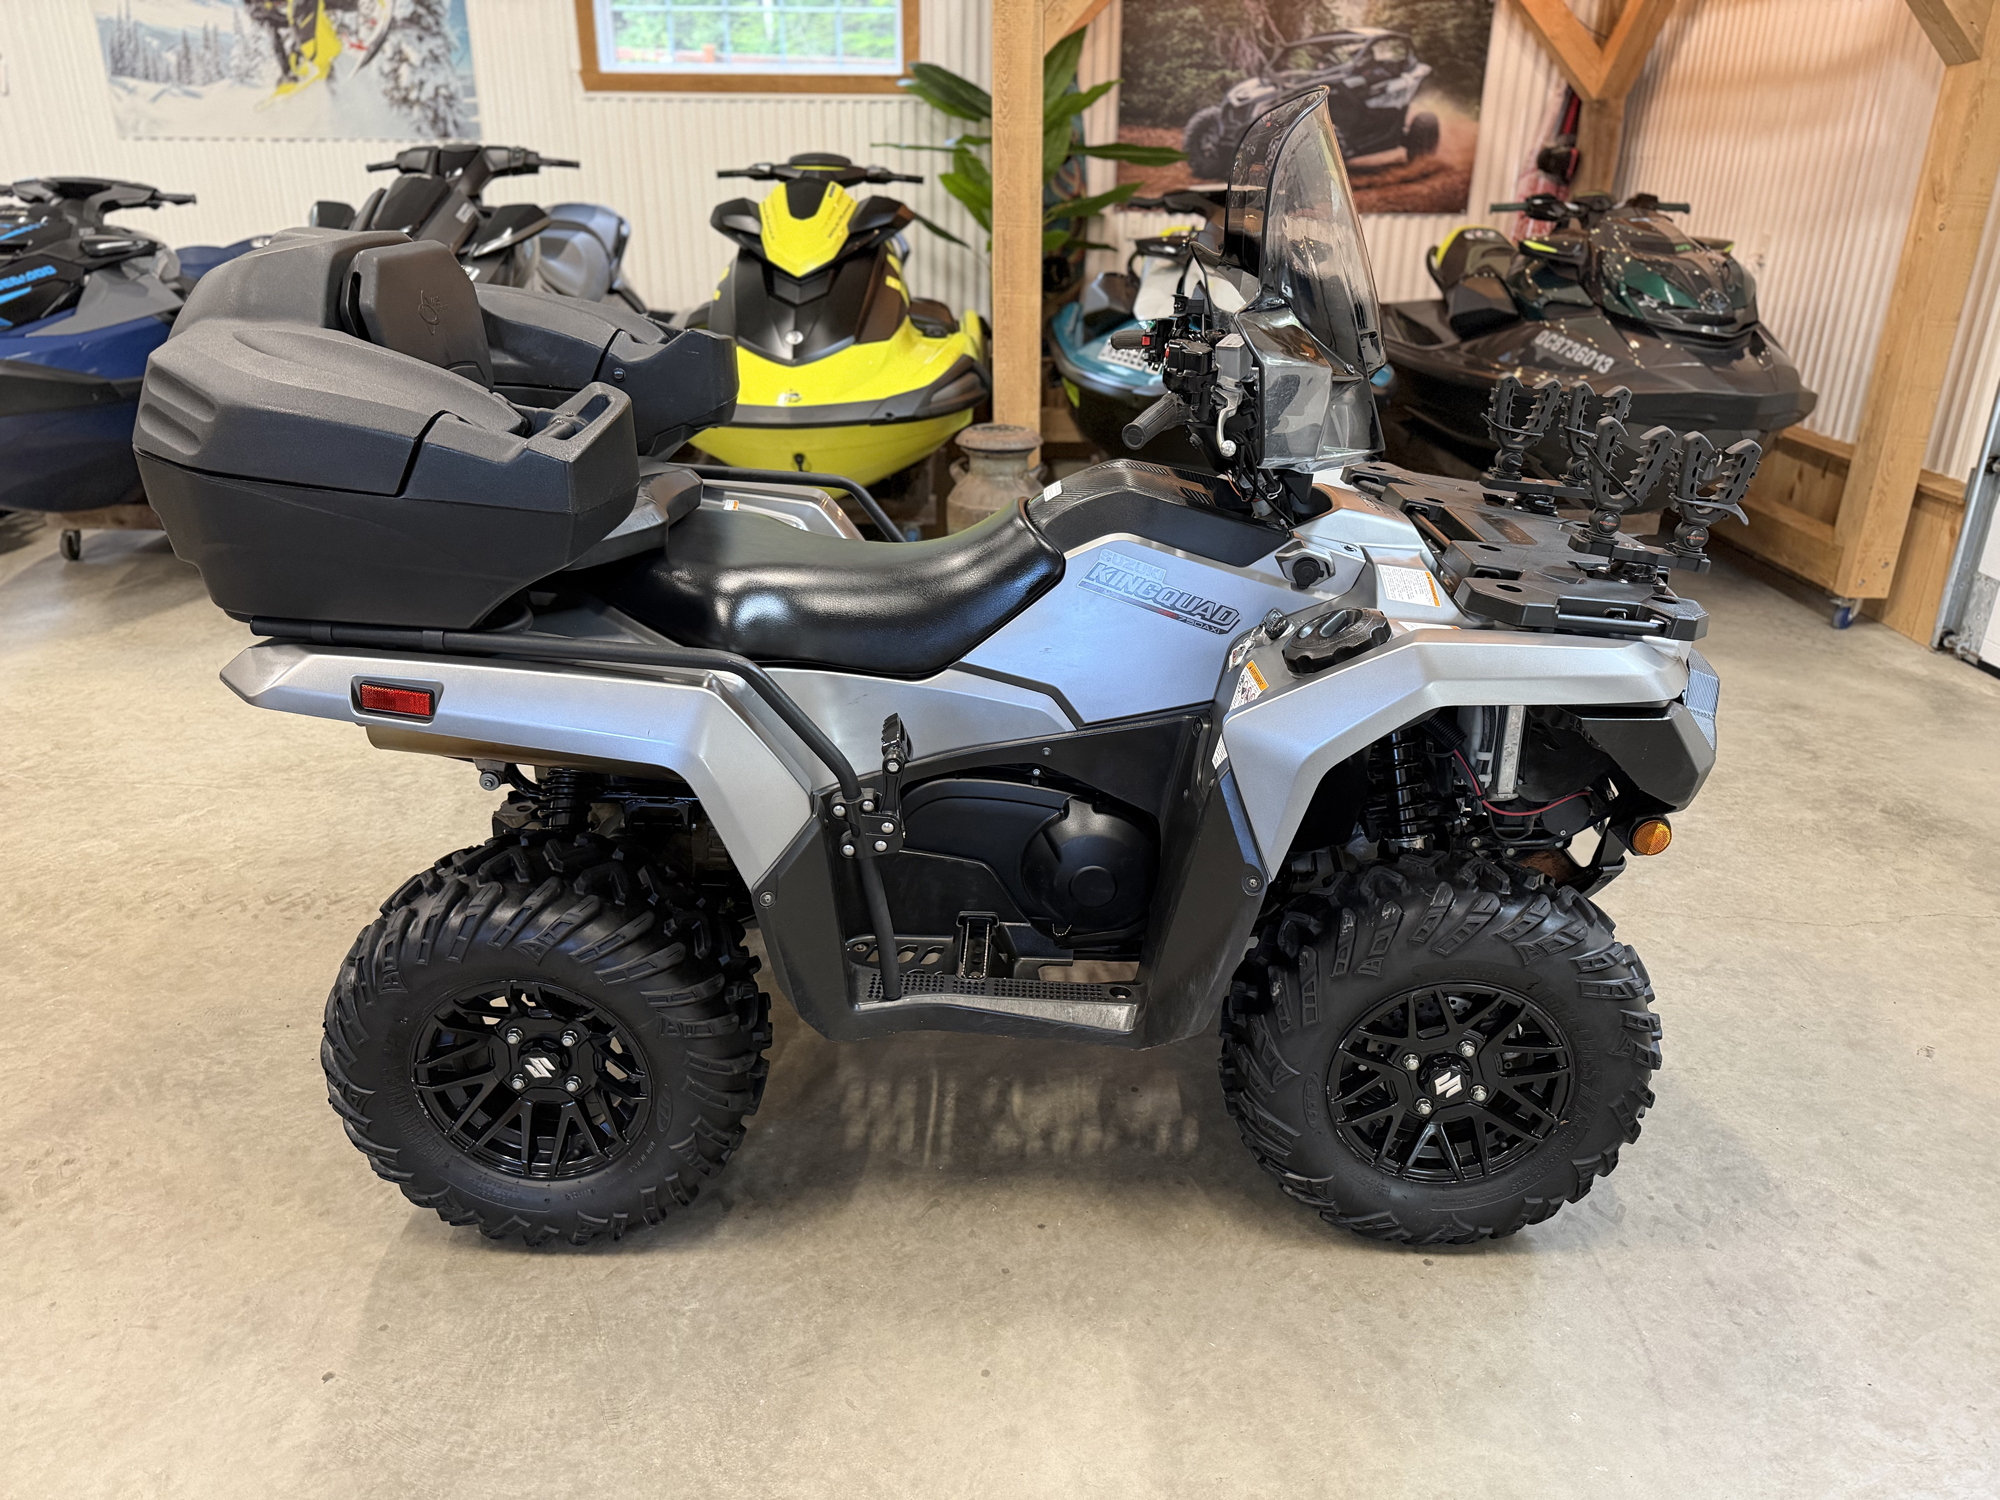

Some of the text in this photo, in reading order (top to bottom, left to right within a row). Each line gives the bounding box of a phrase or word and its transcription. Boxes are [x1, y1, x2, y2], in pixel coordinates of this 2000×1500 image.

[1534, 329, 1615, 375] QC8736013
[1100, 551, 1166, 582] SUZUKI
[1084, 562, 1240, 627] KINGQUAD
